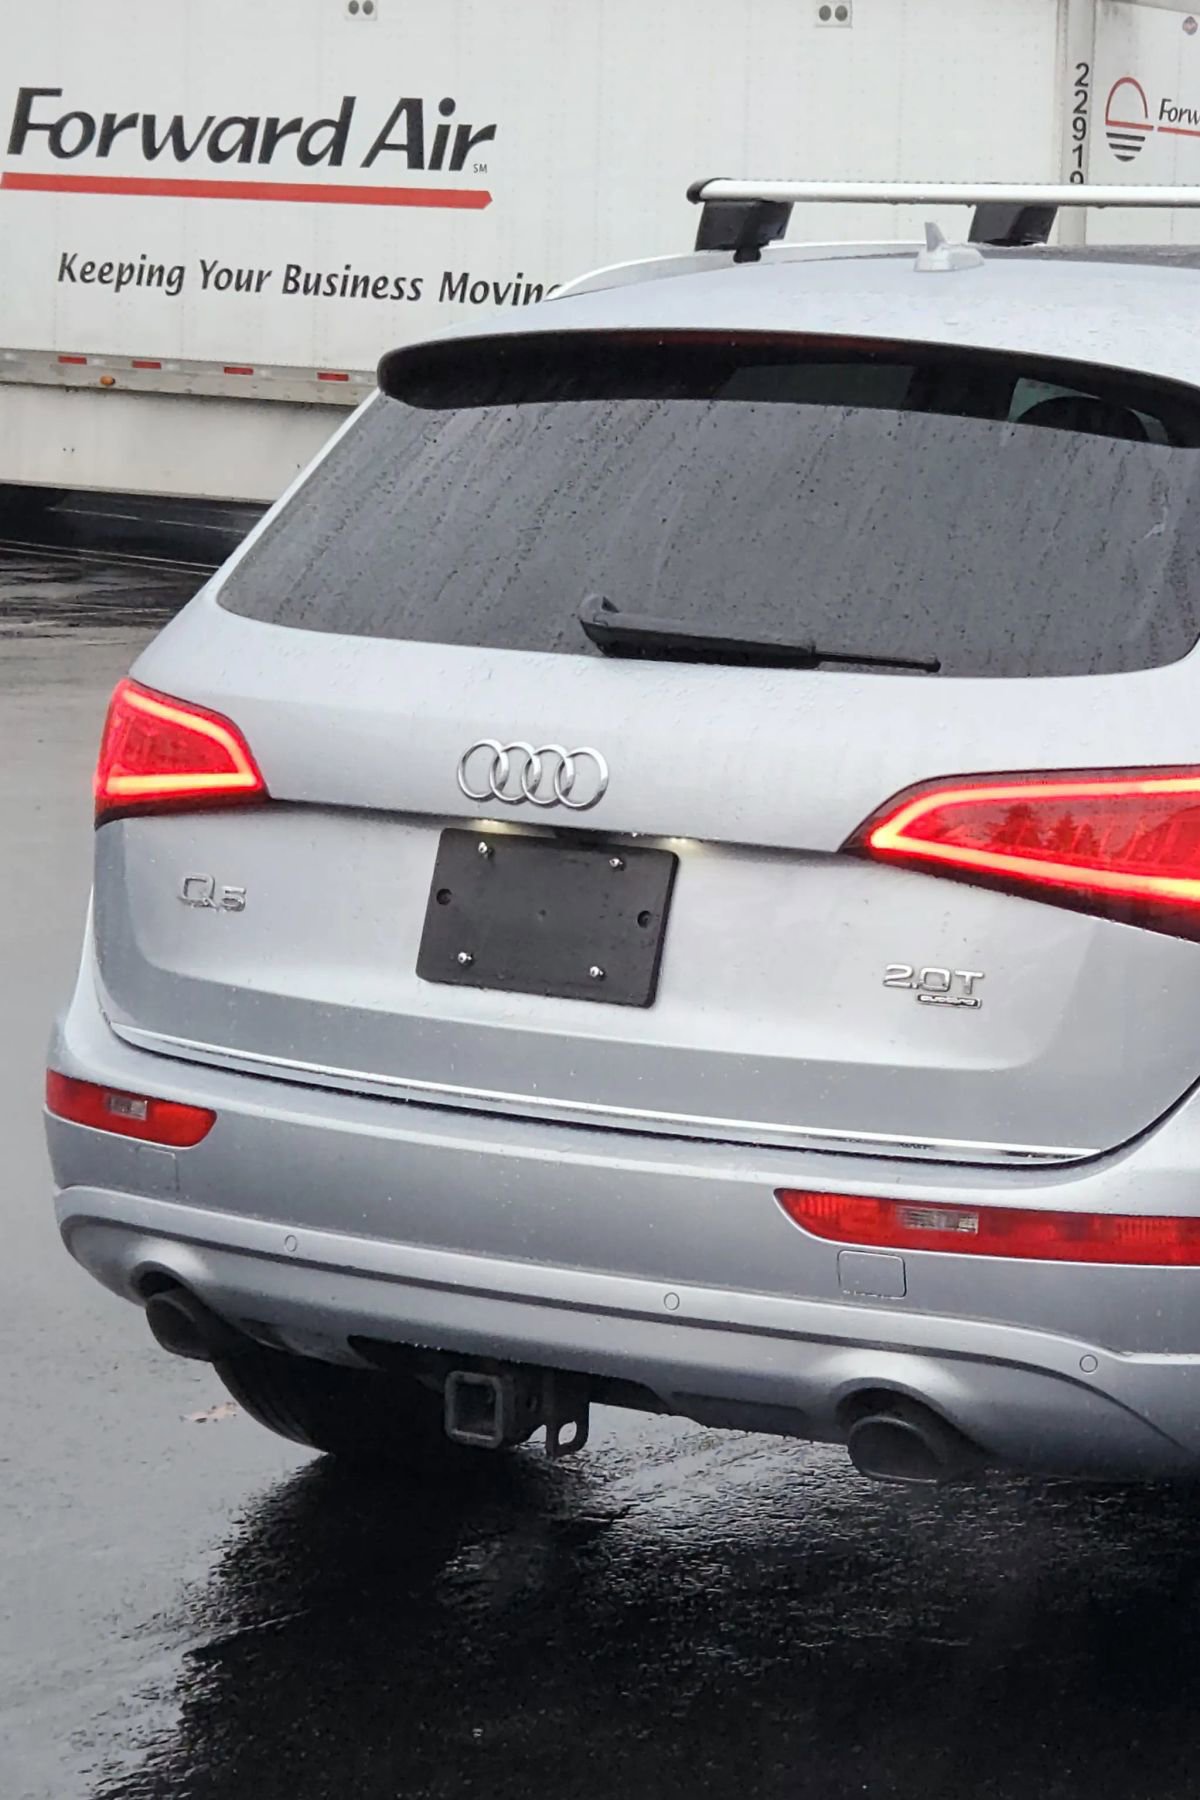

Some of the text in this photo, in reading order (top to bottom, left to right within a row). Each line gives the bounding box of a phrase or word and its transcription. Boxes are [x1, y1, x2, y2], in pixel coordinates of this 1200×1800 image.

[7, 87, 497, 172] Forward Air
[57, 252, 562, 306] Keeping Your Business Movin
[179, 873, 246, 912] Q5
[884, 963, 984, 994] 2.0T
